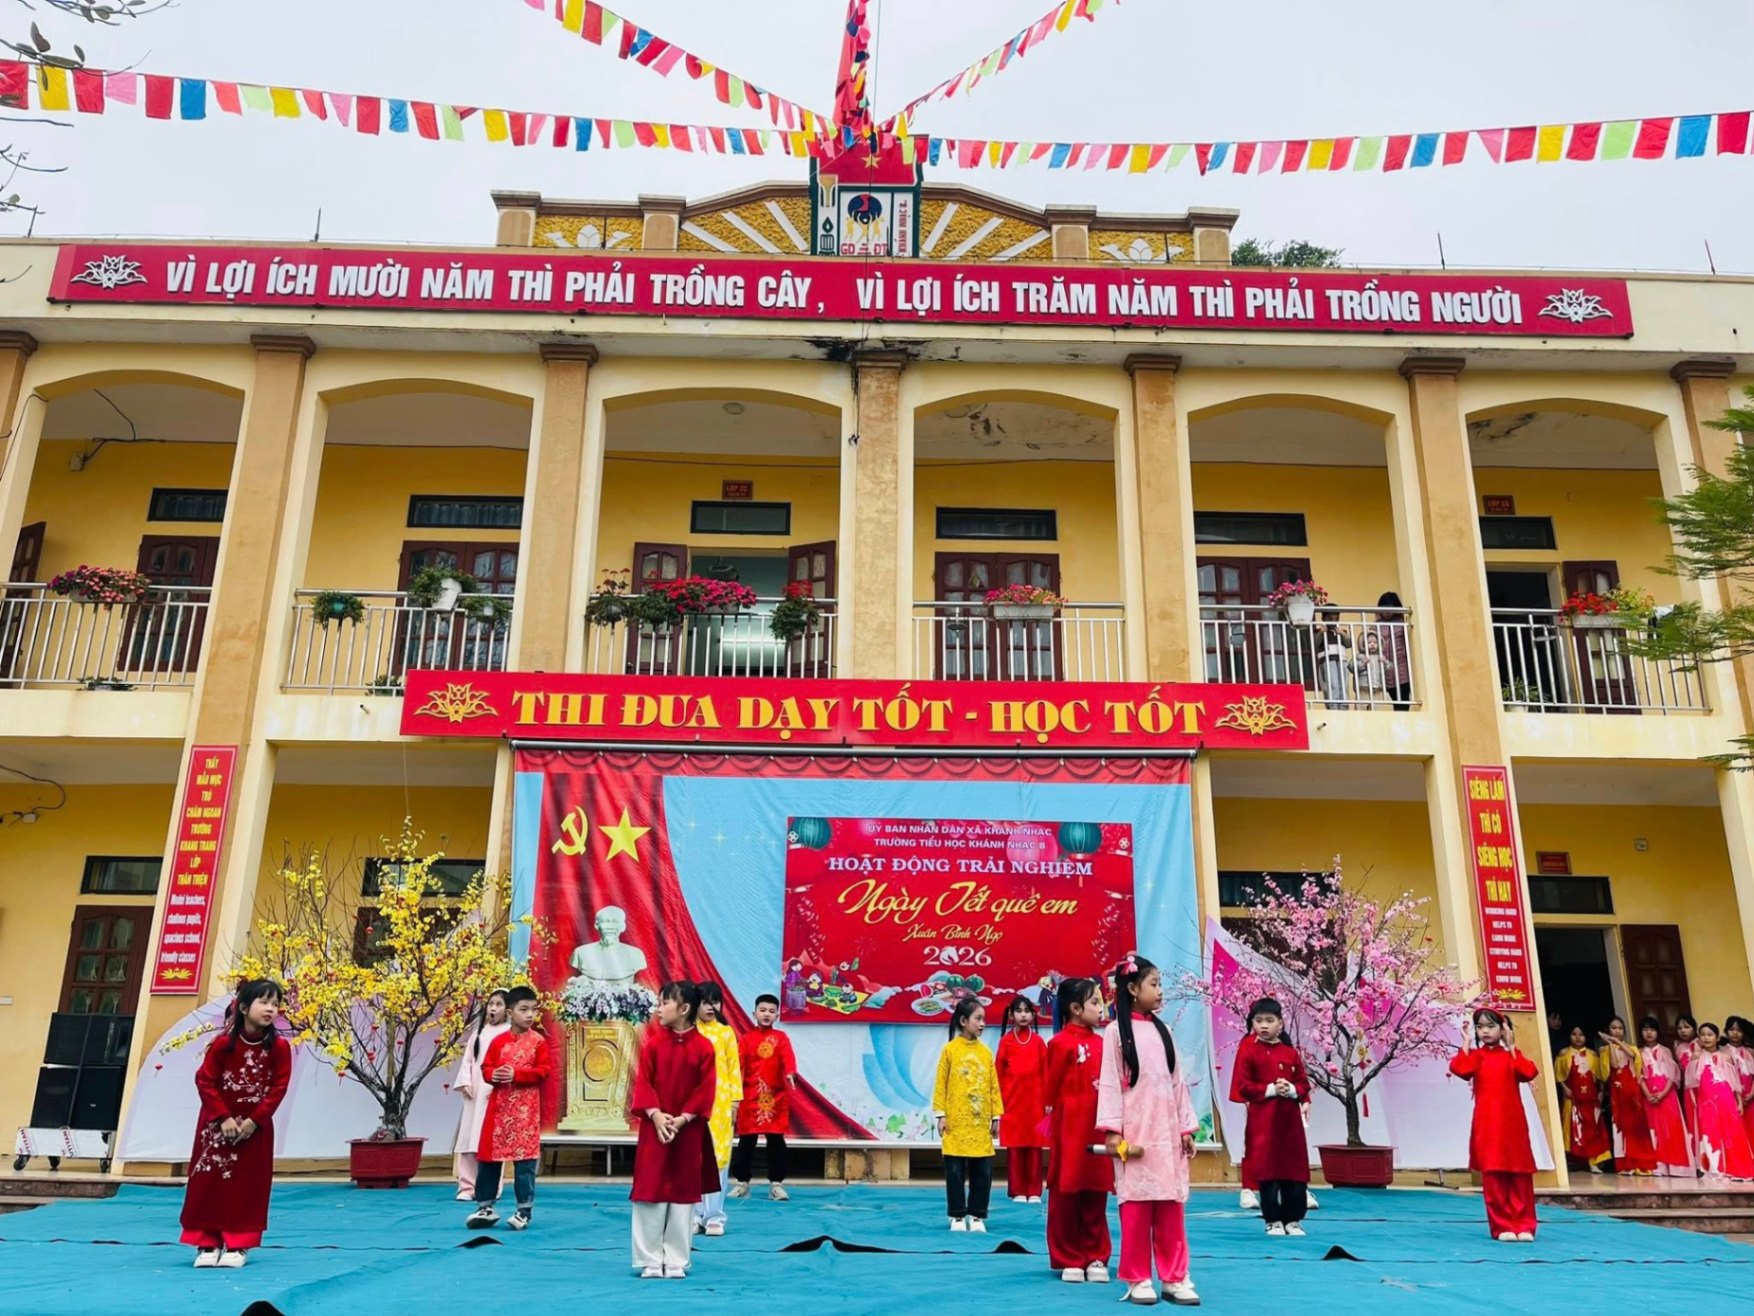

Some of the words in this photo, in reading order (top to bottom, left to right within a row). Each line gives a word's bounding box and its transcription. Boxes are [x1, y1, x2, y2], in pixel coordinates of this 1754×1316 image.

[841, 242, 855, 255] GD
[167, 255, 195, 292] VÌ
[206, 260, 256, 299] LỢI
[266, 256, 315, 295] ÍCH
[328, 258, 408, 298] MƯỜI
[420, 261, 494, 300] NĂM
[508, 263, 553, 301] THÌ
[564, 261, 635, 304] PHẢI
[650, 263, 745, 307] TRỒNG
[856, 271, 884, 310] VÌ
[897, 276, 941, 317] LỢI
[953, 273, 1000, 312] ÍCH
[1013, 276, 1097, 314] TRĂM
[1108, 278, 1178, 316] NĂM
[1189, 279, 1235, 318] THÌ
[1245, 277, 1315, 320] PHẢI
[1325, 278, 1421, 322] TRỒNG
[1431, 285, 1523, 324] NGƯỜI
[512, 690, 607, 725] THI
[620, 693, 721, 728] ĐUA
[738, 696, 839, 740] DẠY
[853, 682, 953, 732] TỐT
[989, 699, 1091, 744] HỌC
[1104, 685, 1206, 735] TỐT
[885, 825, 907, 833] BAN
[873, 836, 917, 847] TRƯỜNG
[918, 835, 942, 848] TIỂU
[944, 839, 967, 850] HỌC
[968, 838, 1006, 849] KHÁNH
[828, 857, 887, 875] HOẠT
[891, 855, 951, 876] ĐỘNG
[957, 855, 1005, 874] TRẢI
[1010, 858, 1094, 879] NGHIỆM
[837, 878, 929, 925] Ngày
[934, 881, 992, 917] Tết
[990, 893, 1041, 922] quê
[1040, 898, 1079, 915] em
[902, 922, 938, 942] Xuân
[923, 945, 993, 967] 2026
